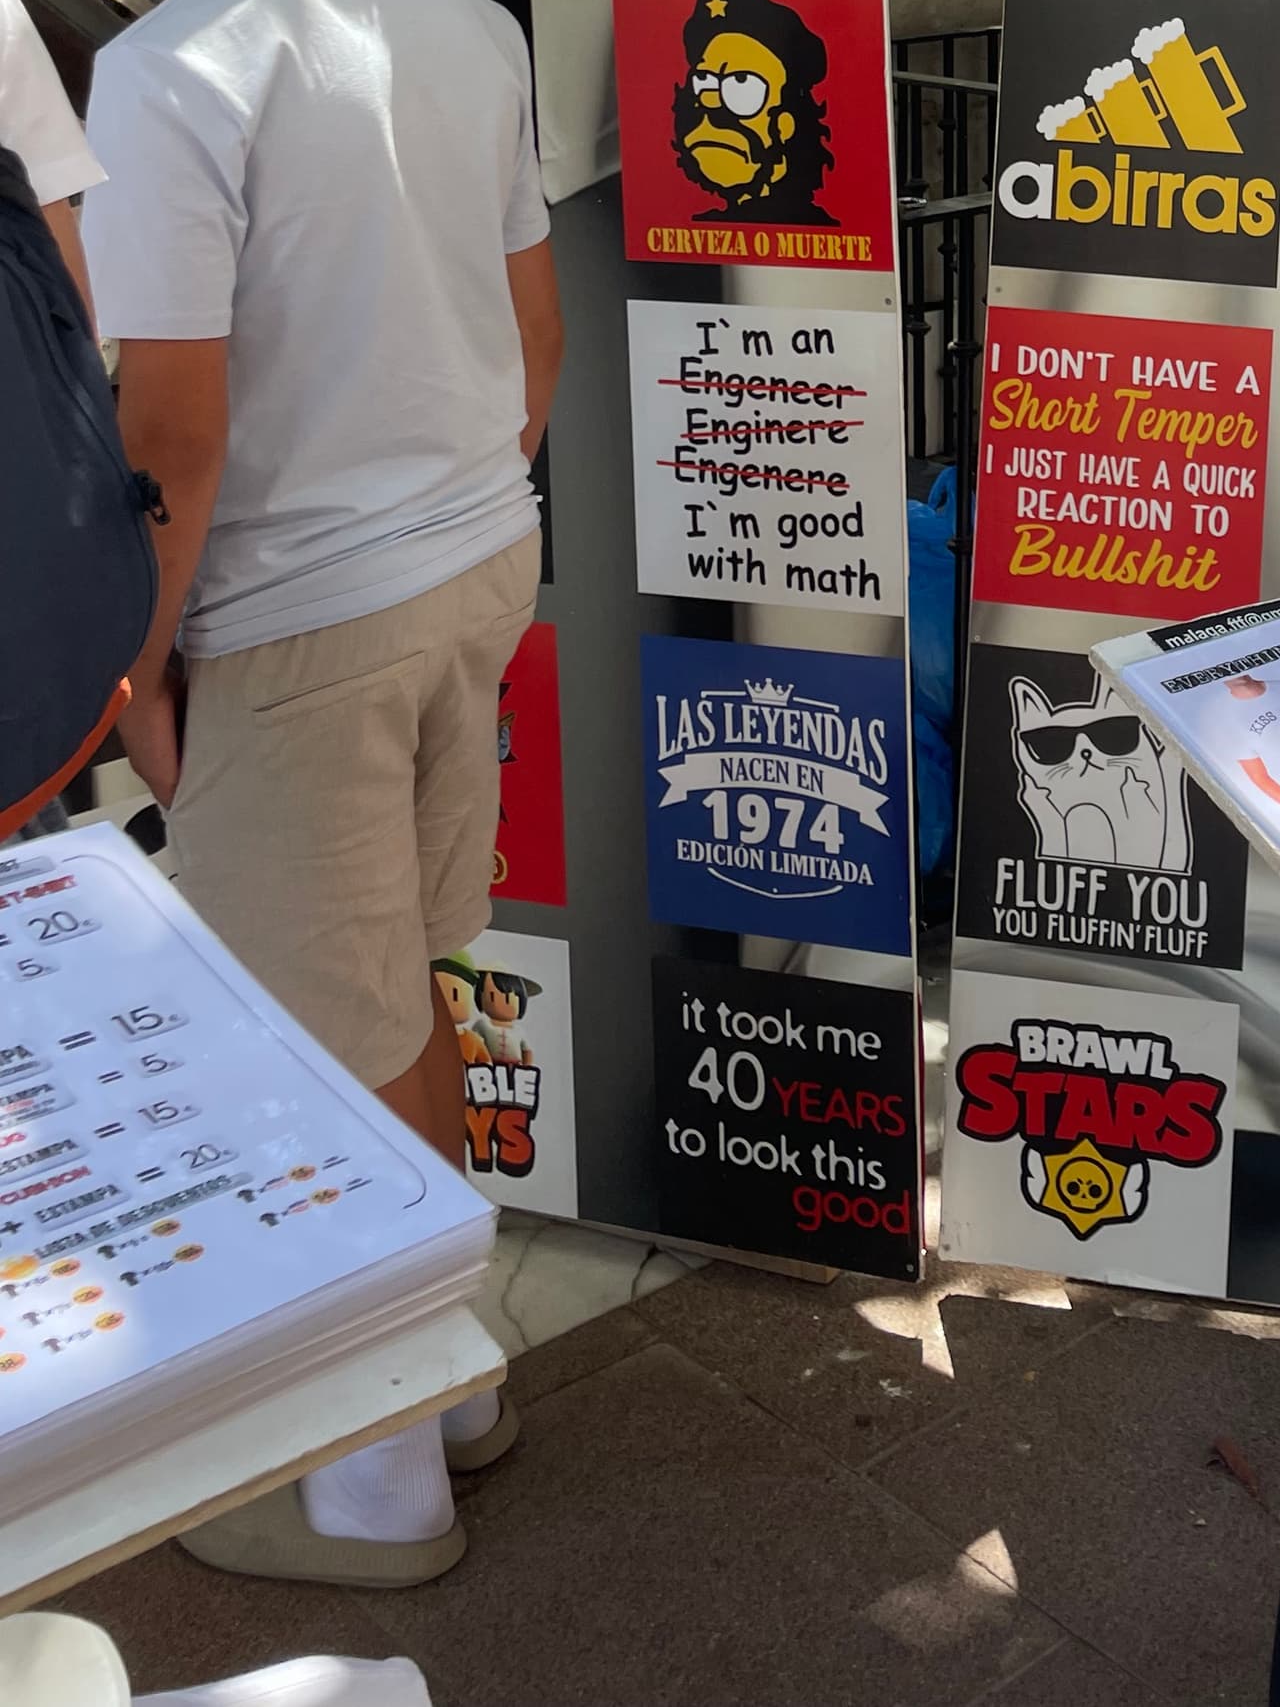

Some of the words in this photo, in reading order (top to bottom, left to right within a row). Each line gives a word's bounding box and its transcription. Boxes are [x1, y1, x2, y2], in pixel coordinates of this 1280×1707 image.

[998, 148, 1276, 236] abirras
[647, 227, 748, 256] CERVEZA
[754, 232, 770, 256] O
[777, 232, 872, 262] MUERTE
[989, 377, 1101, 435] Short
[1113, 388, 1258, 459] Temper
[1017, 486, 1173, 532] REACTION
[1190, 503, 1229, 538] TO
[688, 547, 766, 586] with
[786, 559, 881, 600] math
[1008, 523, 1222, 592] Bullshit
[656, 695, 715, 761] LAS
[723, 703, 888, 785] LEYENDAS
[1250, 712, 1277, 734] KISS
[719, 757, 790, 786] NACEN
[796, 764, 824, 795] EN
[702, 790, 844, 855] 1974
[676, 838, 764, 871] EDICIÓN
[770, 850, 874, 886] LIMITADA
[995, 857, 1108, 916] FLUFF
[1127, 873, 1208, 927] YOU
[992, 907, 1038, 938] YOU
[1047, 914, 1141, 948] FLUFFIN'
[1145, 925, 1209, 959] FLUFF
[682, 991, 706, 1033] it
[717, 1002, 806, 1050] took
[817, 1025, 882, 1060] me
[688, 1047, 766, 1111] 40
[772, 1077, 906, 1137] YEARS
[665, 1117, 706, 1157] to
[718, 1121, 803, 1176] look
[812, 1139, 886, 1190] this
[792, 1185, 910, 1234] good
